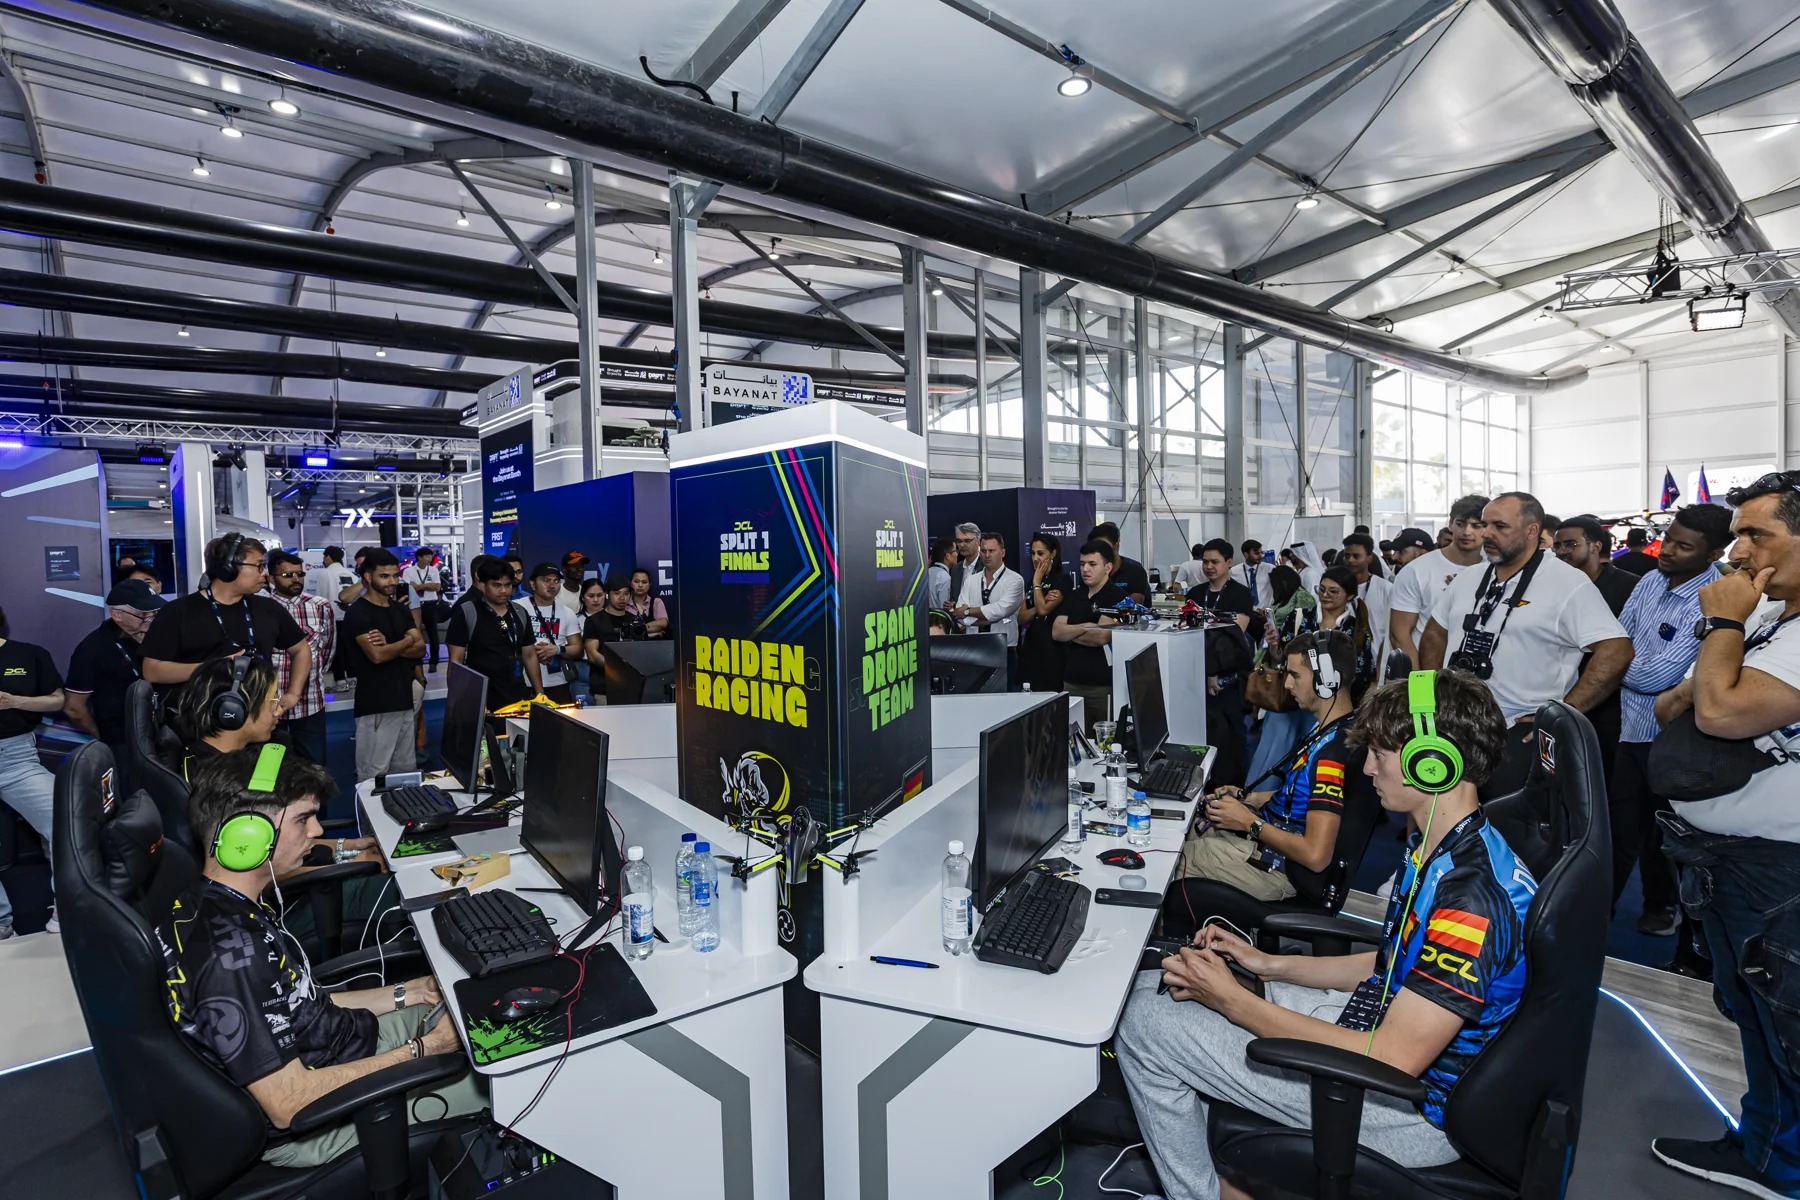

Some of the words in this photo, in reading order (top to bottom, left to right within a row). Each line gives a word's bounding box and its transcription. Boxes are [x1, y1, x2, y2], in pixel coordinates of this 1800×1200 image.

[713, 370, 778, 388] بيانات
[713, 386, 778, 400] BAYANAT
[340, 508, 375, 528] 7X
[720, 531, 758, 551] SPLIT
[761, 531, 769, 549] 1
[875, 529, 898, 548] SPLIT
[898, 531, 904, 548] 1
[720, 551, 770, 571] FINALS
[875, 549, 904, 568] FINALS
[864, 604, 915, 653] SPAIN
[695, 635, 805, 686] RAIDEN
[862, 639, 918, 695] DRONE
[695, 671, 808, 728] RACING
[868, 676, 915, 732] TEAM
[1420, 944, 1479, 983] DCL
